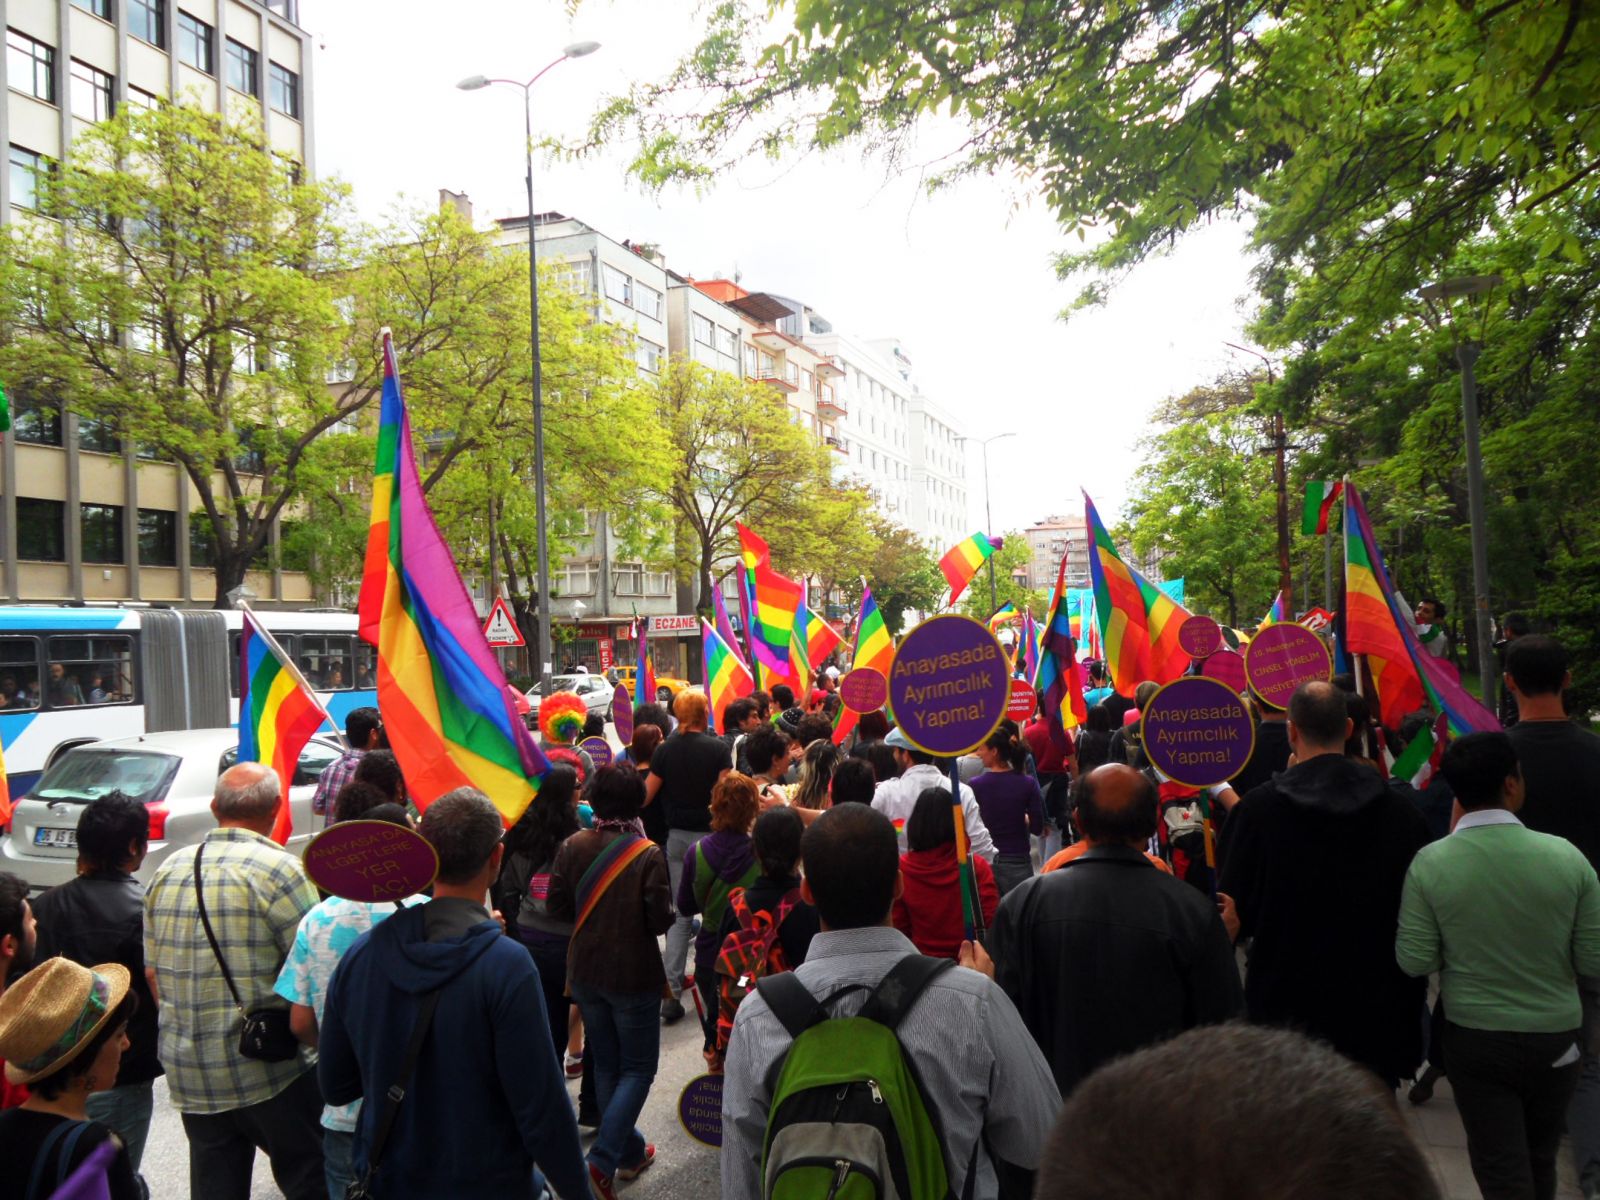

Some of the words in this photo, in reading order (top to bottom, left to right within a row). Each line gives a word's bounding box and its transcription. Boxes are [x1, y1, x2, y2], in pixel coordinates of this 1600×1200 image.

[655, 617, 695, 629] ECZANE
[893, 642, 998, 679] Anayasada
[902, 670, 993, 706] Ayrımcılık
[913, 698, 986, 730] Yapma!
[1148, 703, 1243, 724] Anayasada
[1157, 724, 1239, 745] Ayrımcılık
[1166, 747, 1231, 766] Yapma!
[355, 859, 401, 880] YER
[372, 876, 414, 898] AÇ!
